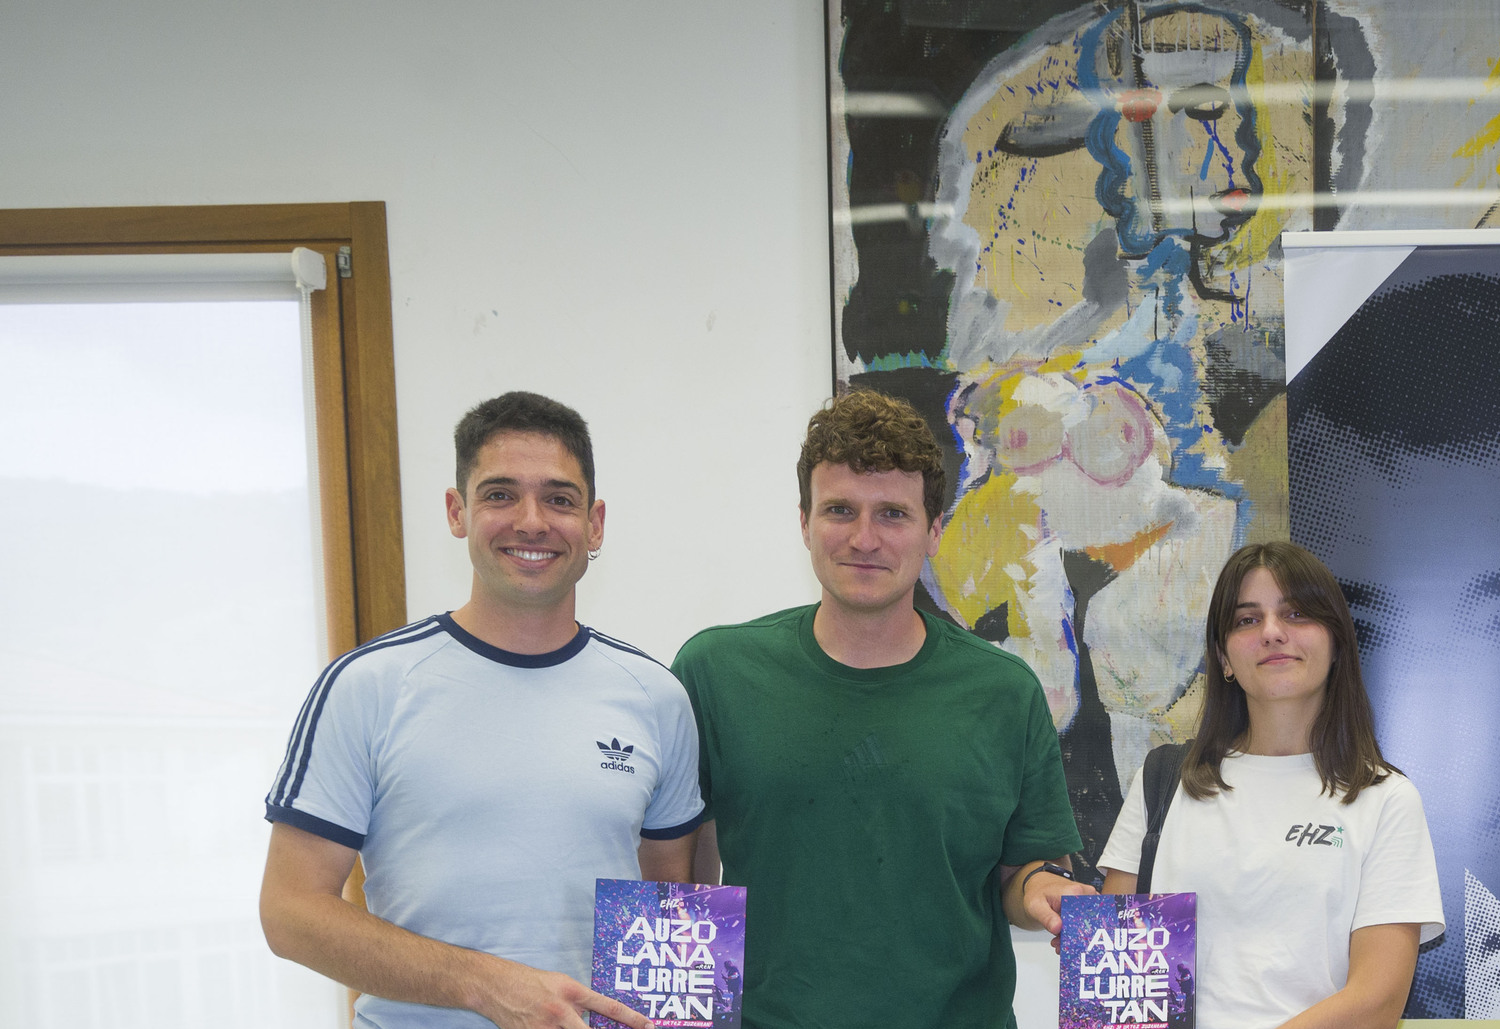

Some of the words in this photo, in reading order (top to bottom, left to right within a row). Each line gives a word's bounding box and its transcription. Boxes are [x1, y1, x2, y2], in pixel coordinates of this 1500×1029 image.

[600, 760, 635, 774] adidas
[1285, 822, 1336, 847] EHZ
[624, 917, 717, 944] AUZO
[1086, 927, 1170, 951] AUZO
[616, 941, 716, 968] LANA
[1080, 950, 1169, 975] LANA
[615, 967, 715, 994] LURRE
[1079, 975, 1169, 999] LURRE
[642, 994, 713, 1020] TAN
[1103, 1000, 1168, 1023] TAN
